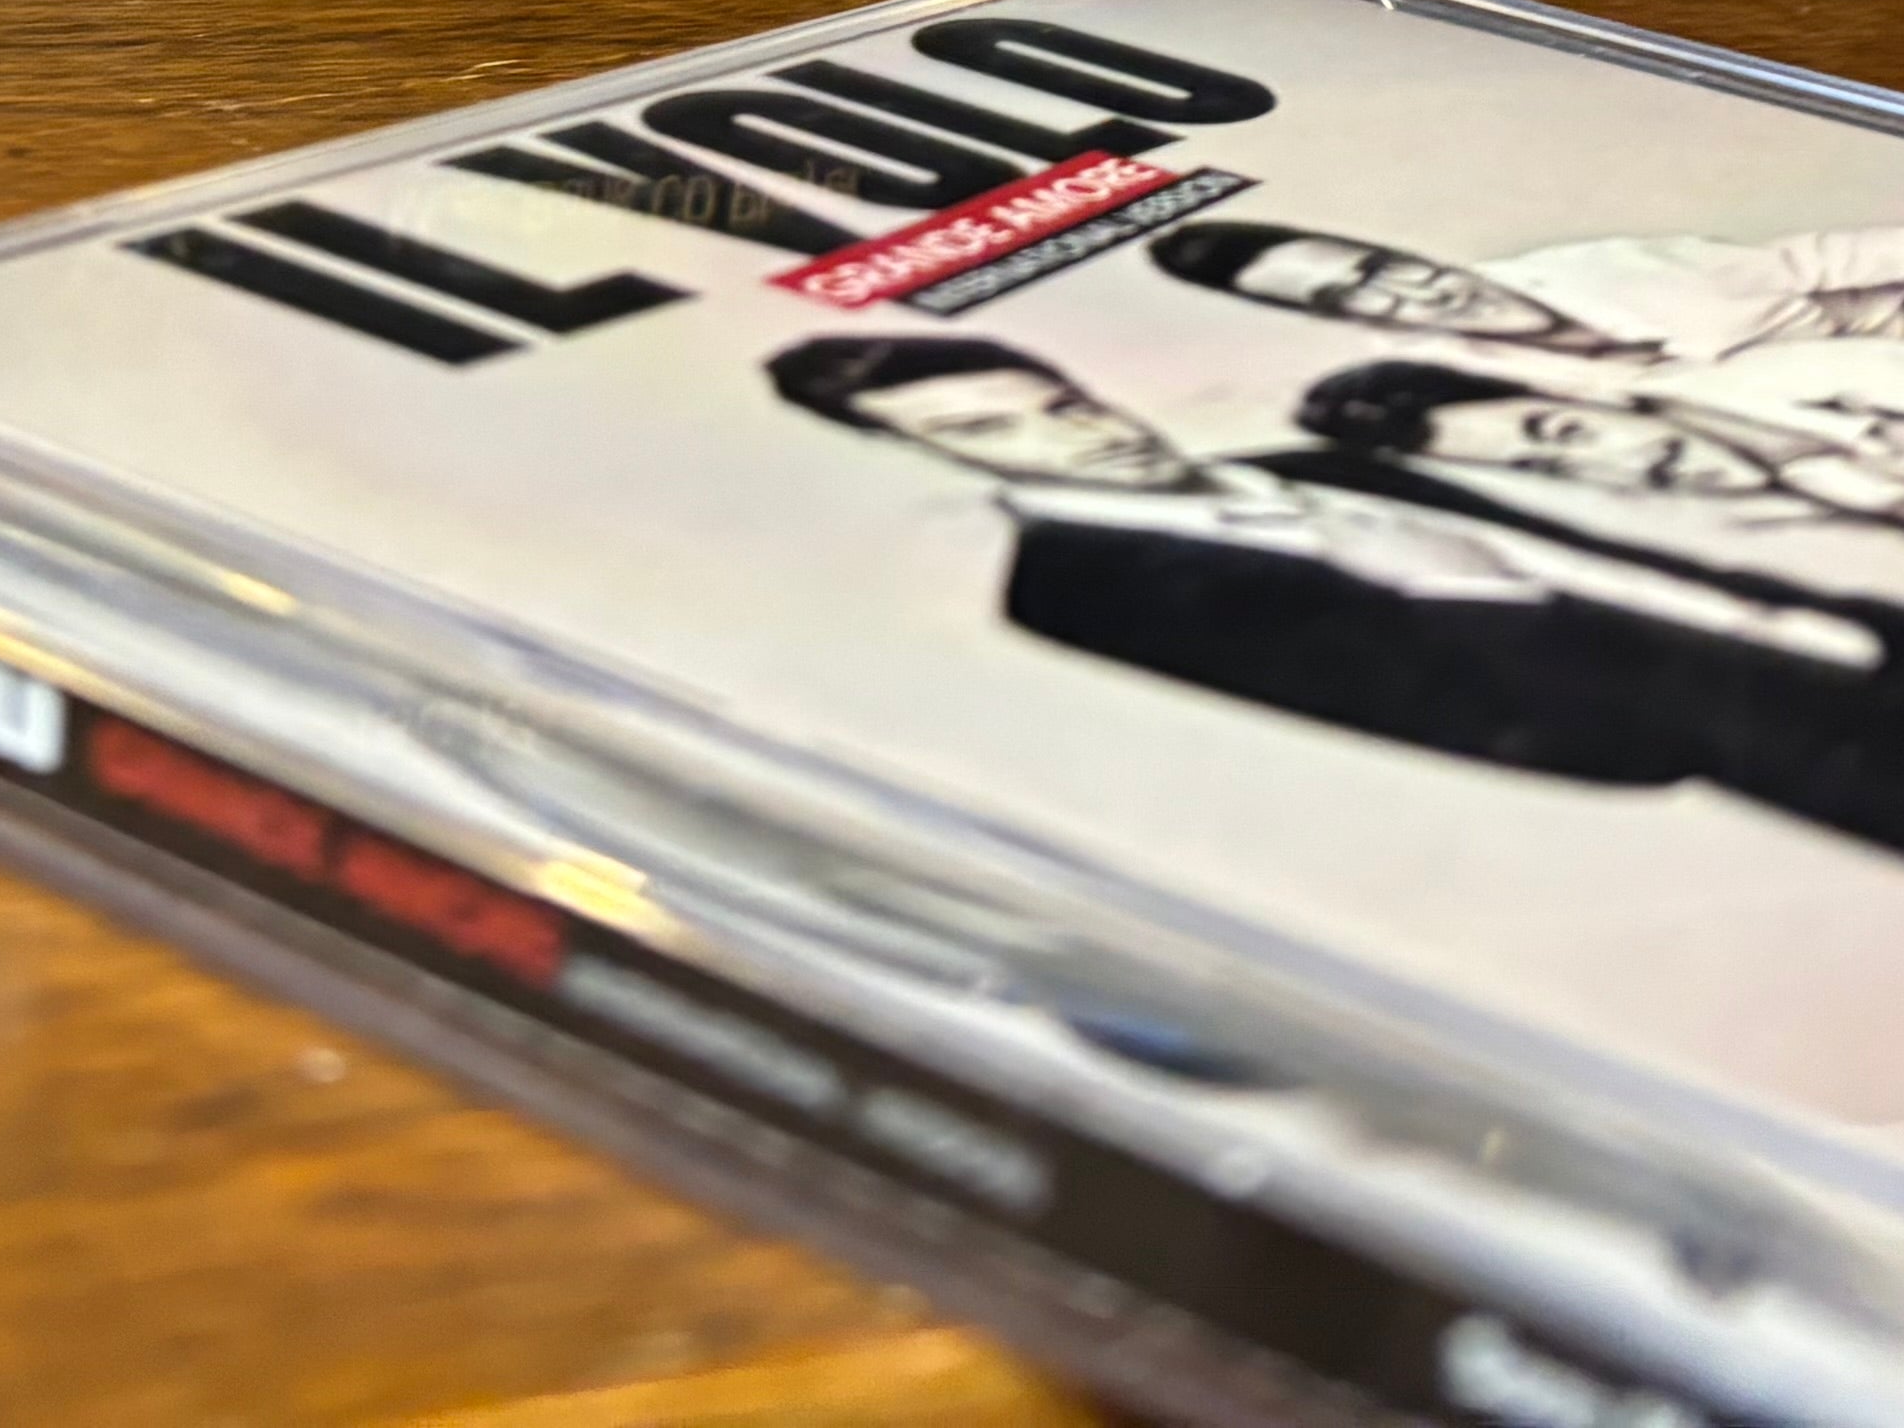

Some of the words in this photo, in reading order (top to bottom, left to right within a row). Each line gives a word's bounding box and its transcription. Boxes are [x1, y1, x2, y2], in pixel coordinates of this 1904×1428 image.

[117, 198, 702, 369] IL
[438, 16, 1278, 256] VOLO
[802, 217, 1010, 305] GRANDE
[990, 156, 1160, 232] AMORE
